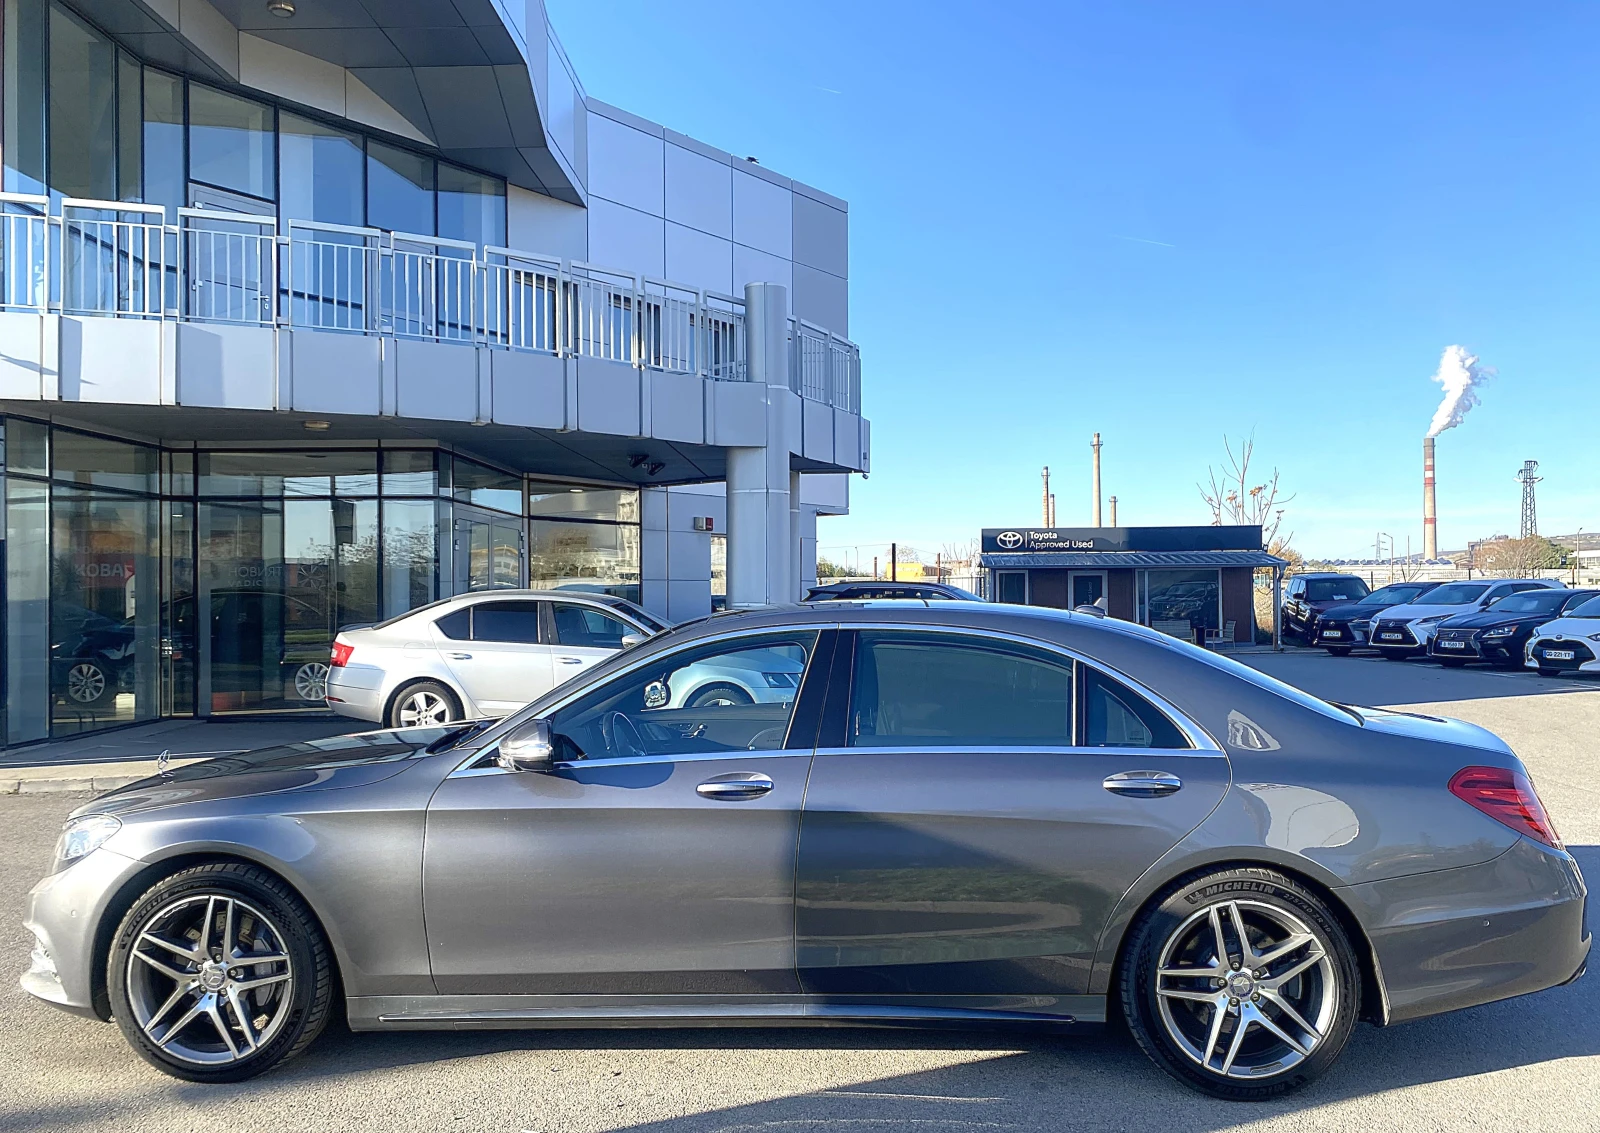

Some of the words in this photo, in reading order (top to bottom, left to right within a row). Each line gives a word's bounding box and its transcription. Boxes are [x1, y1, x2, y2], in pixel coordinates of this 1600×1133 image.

[1029, 531, 1057, 541] Toyota
[1029, 541, 1069, 549] Approved
[1071, 540, 1093, 548] Used
[1205, 881, 1276, 897] MICHELIN
